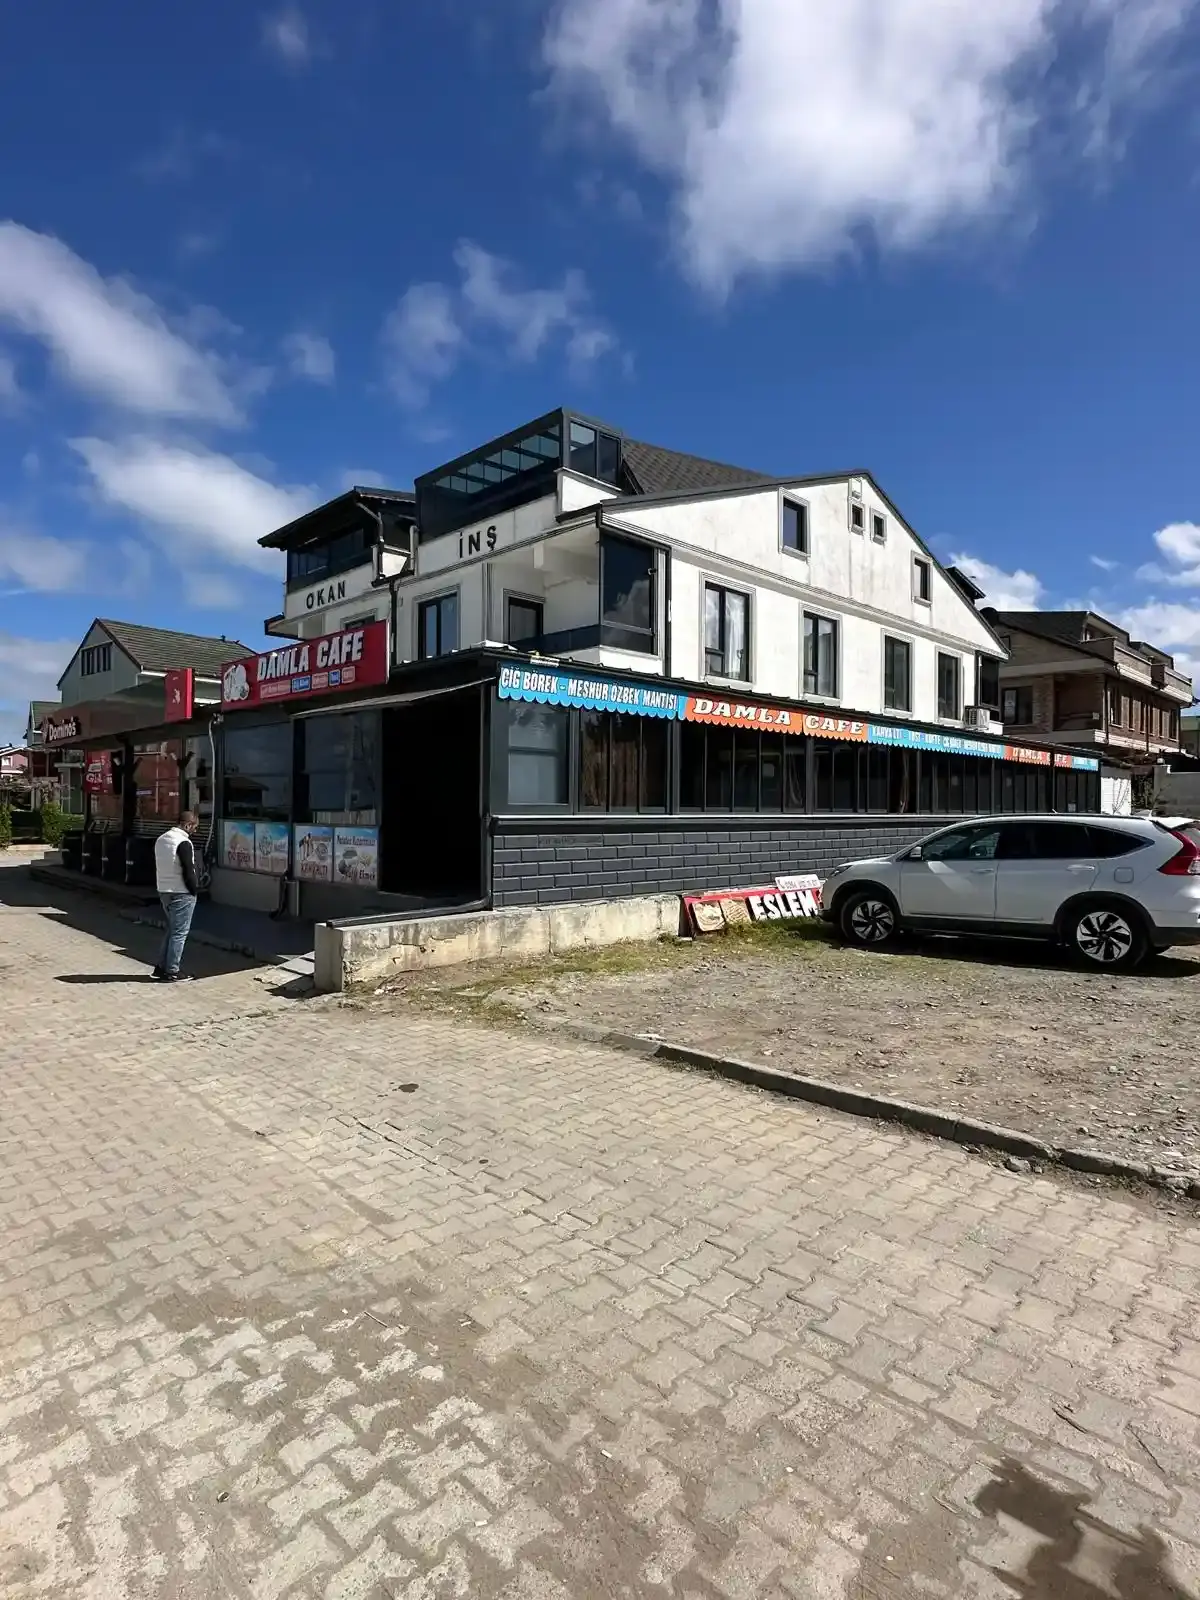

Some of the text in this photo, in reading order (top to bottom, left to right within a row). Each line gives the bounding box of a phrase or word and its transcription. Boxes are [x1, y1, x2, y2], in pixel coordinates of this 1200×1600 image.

[459, 525, 497, 558] İNŞ
[306, 580, 346, 609] OKAN
[257, 645, 310, 681] DAMLA
[316, 630, 364, 669] CAFE
[522, 670, 558, 694] BÖREK
[693, 698, 864, 735] DAMLA CAFE
